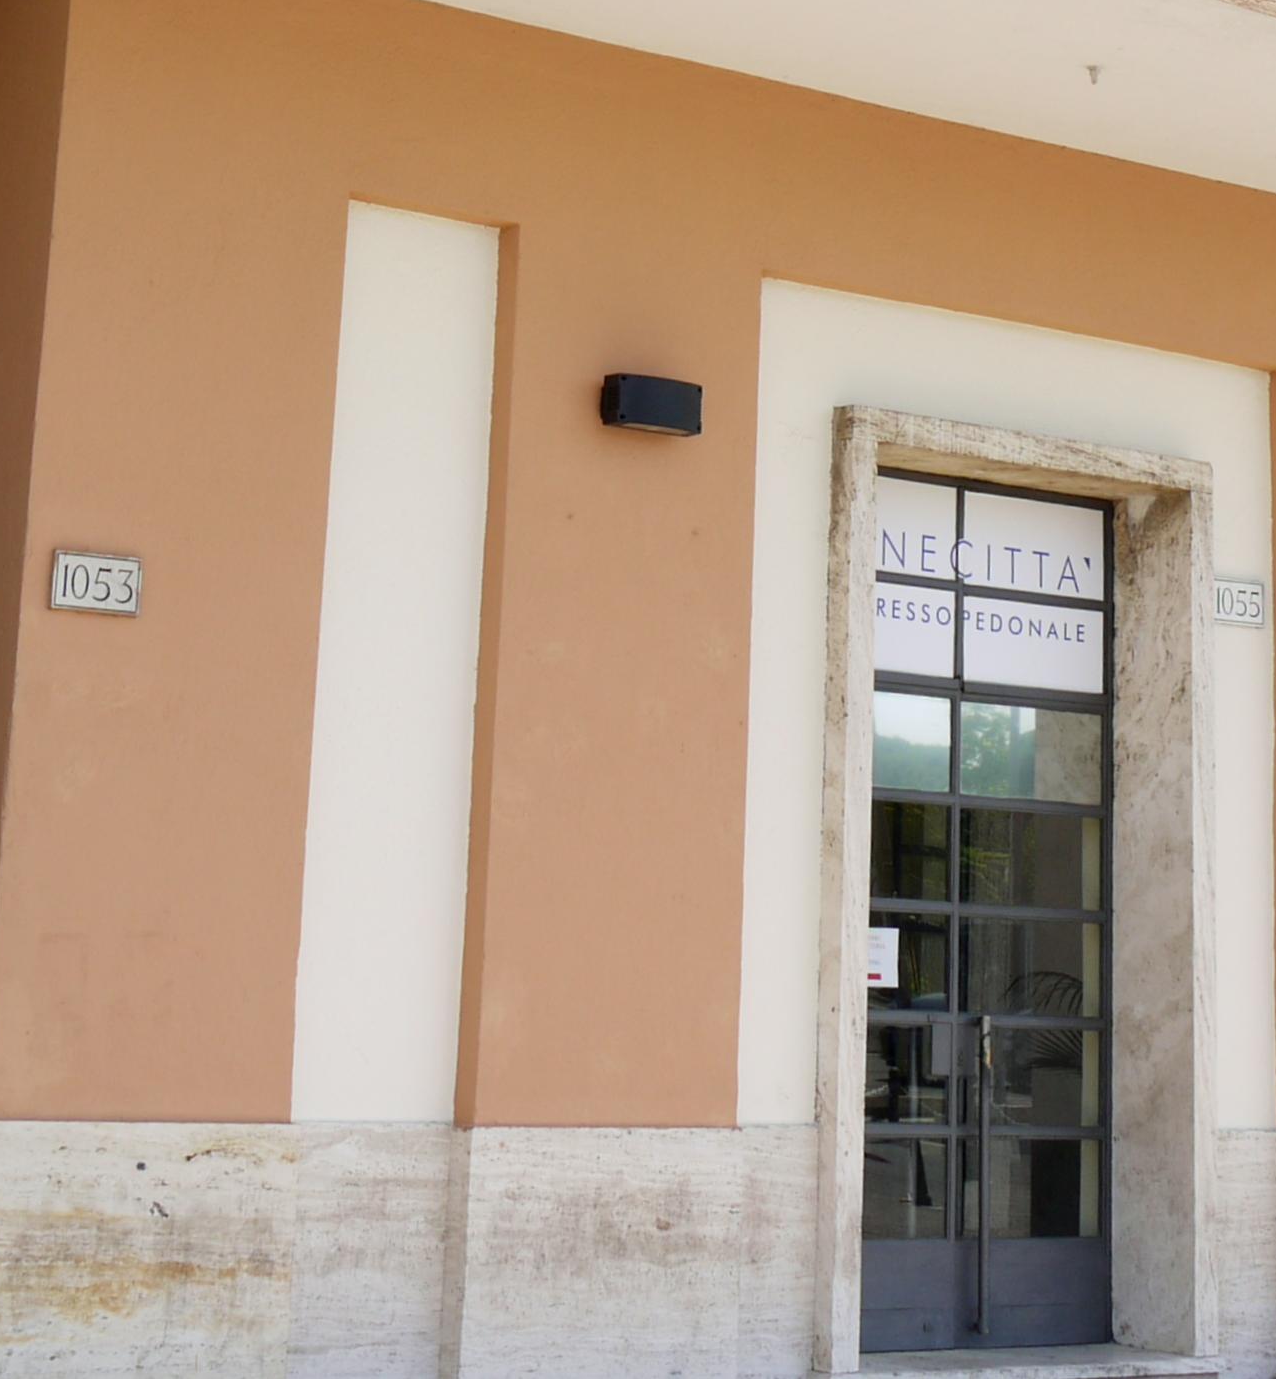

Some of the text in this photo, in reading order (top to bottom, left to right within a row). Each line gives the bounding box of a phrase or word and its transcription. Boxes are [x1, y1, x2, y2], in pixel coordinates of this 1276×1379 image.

[61, 563, 134, 604] 1053
[1216, 586, 1261, 618] 1055
[875, 597, 1086, 643] RESSO PEDONALE
